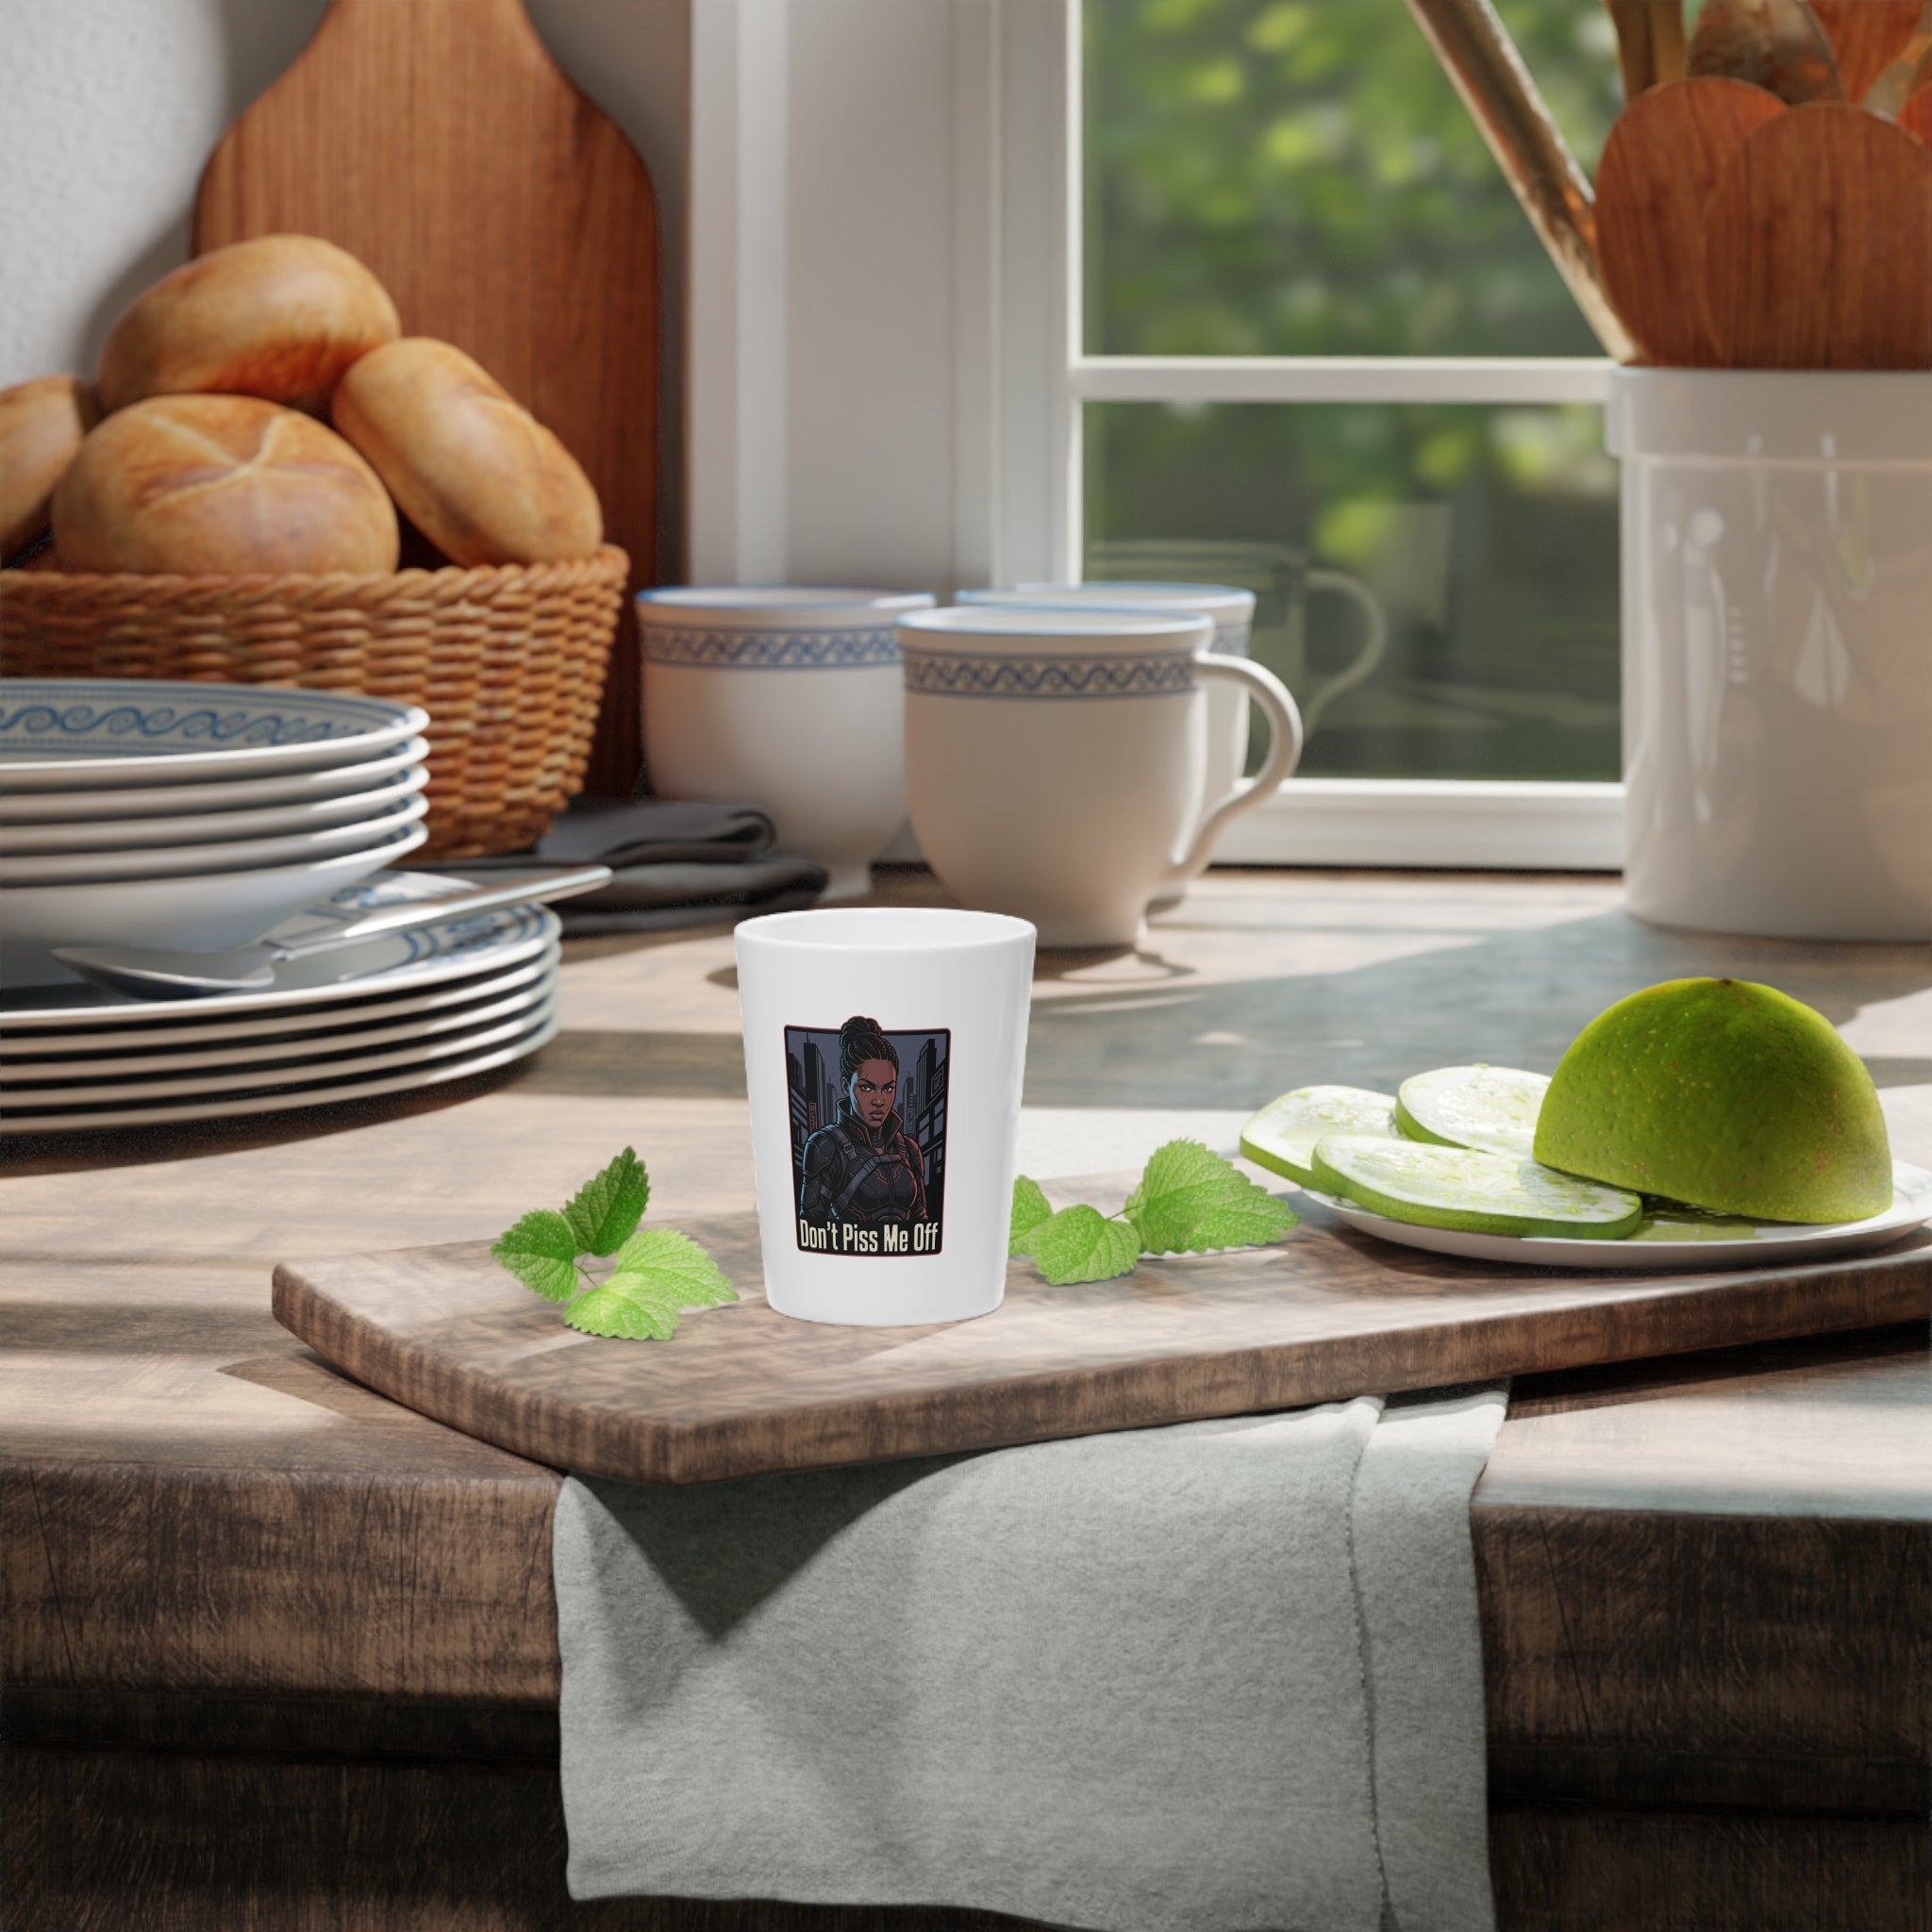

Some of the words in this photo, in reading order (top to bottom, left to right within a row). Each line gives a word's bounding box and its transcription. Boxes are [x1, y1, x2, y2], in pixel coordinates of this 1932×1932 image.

[799, 1219, 839, 1251] Don't
[842, 1223, 878, 1253] Piss
[883, 1224, 908, 1253] Me
[913, 1222, 939, 1252] Off
